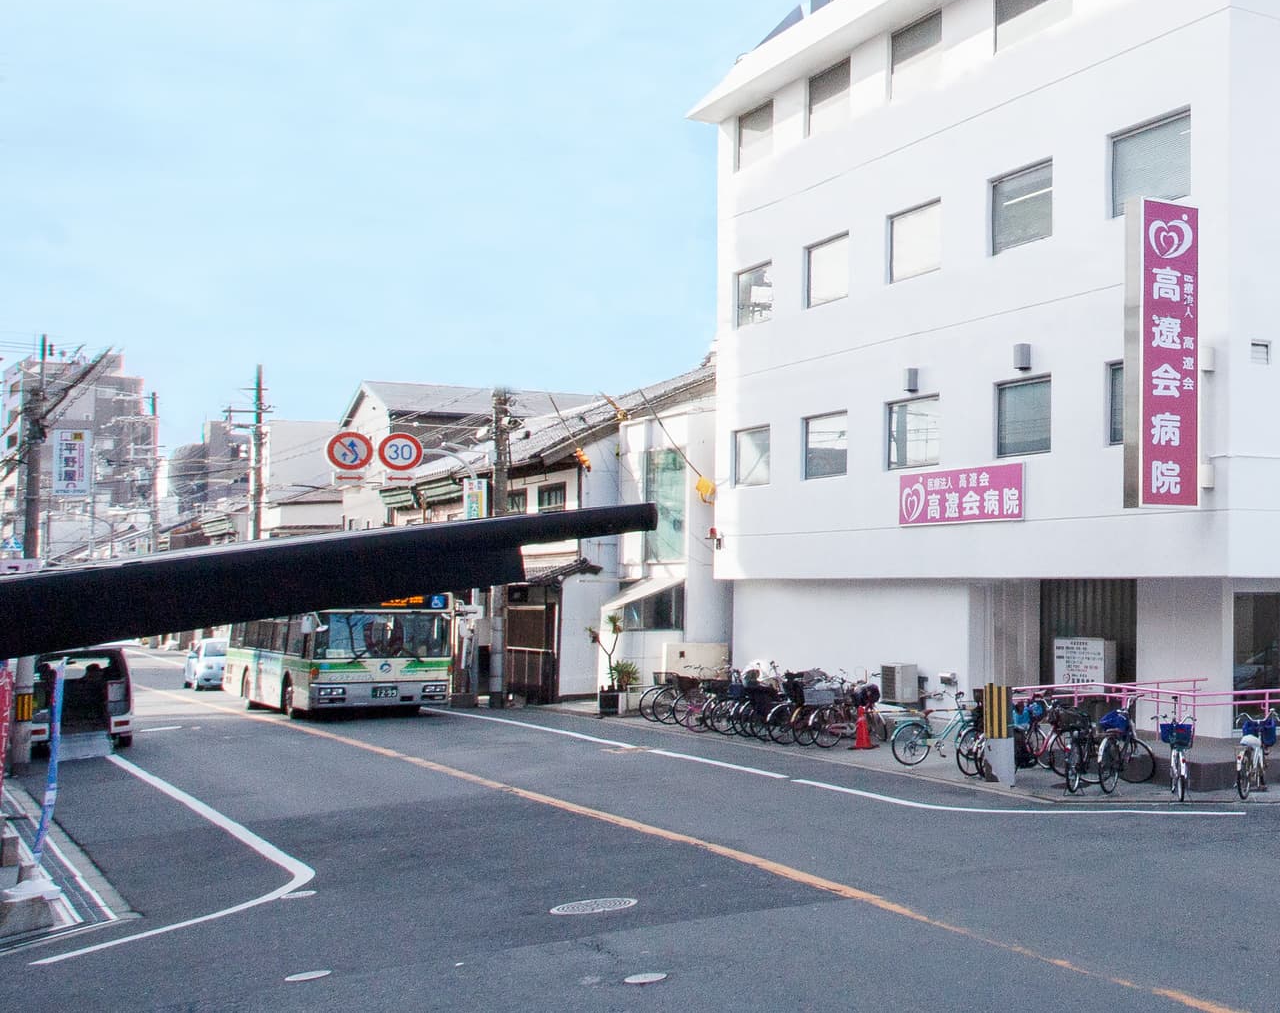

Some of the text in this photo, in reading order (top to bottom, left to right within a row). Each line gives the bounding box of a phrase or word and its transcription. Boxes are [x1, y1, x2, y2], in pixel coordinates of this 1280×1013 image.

[1151, 265, 1182, 496] 高遼会病院
[388, 443, 413, 461] 30
[927, 487, 1020, 520] 高遼会病院
